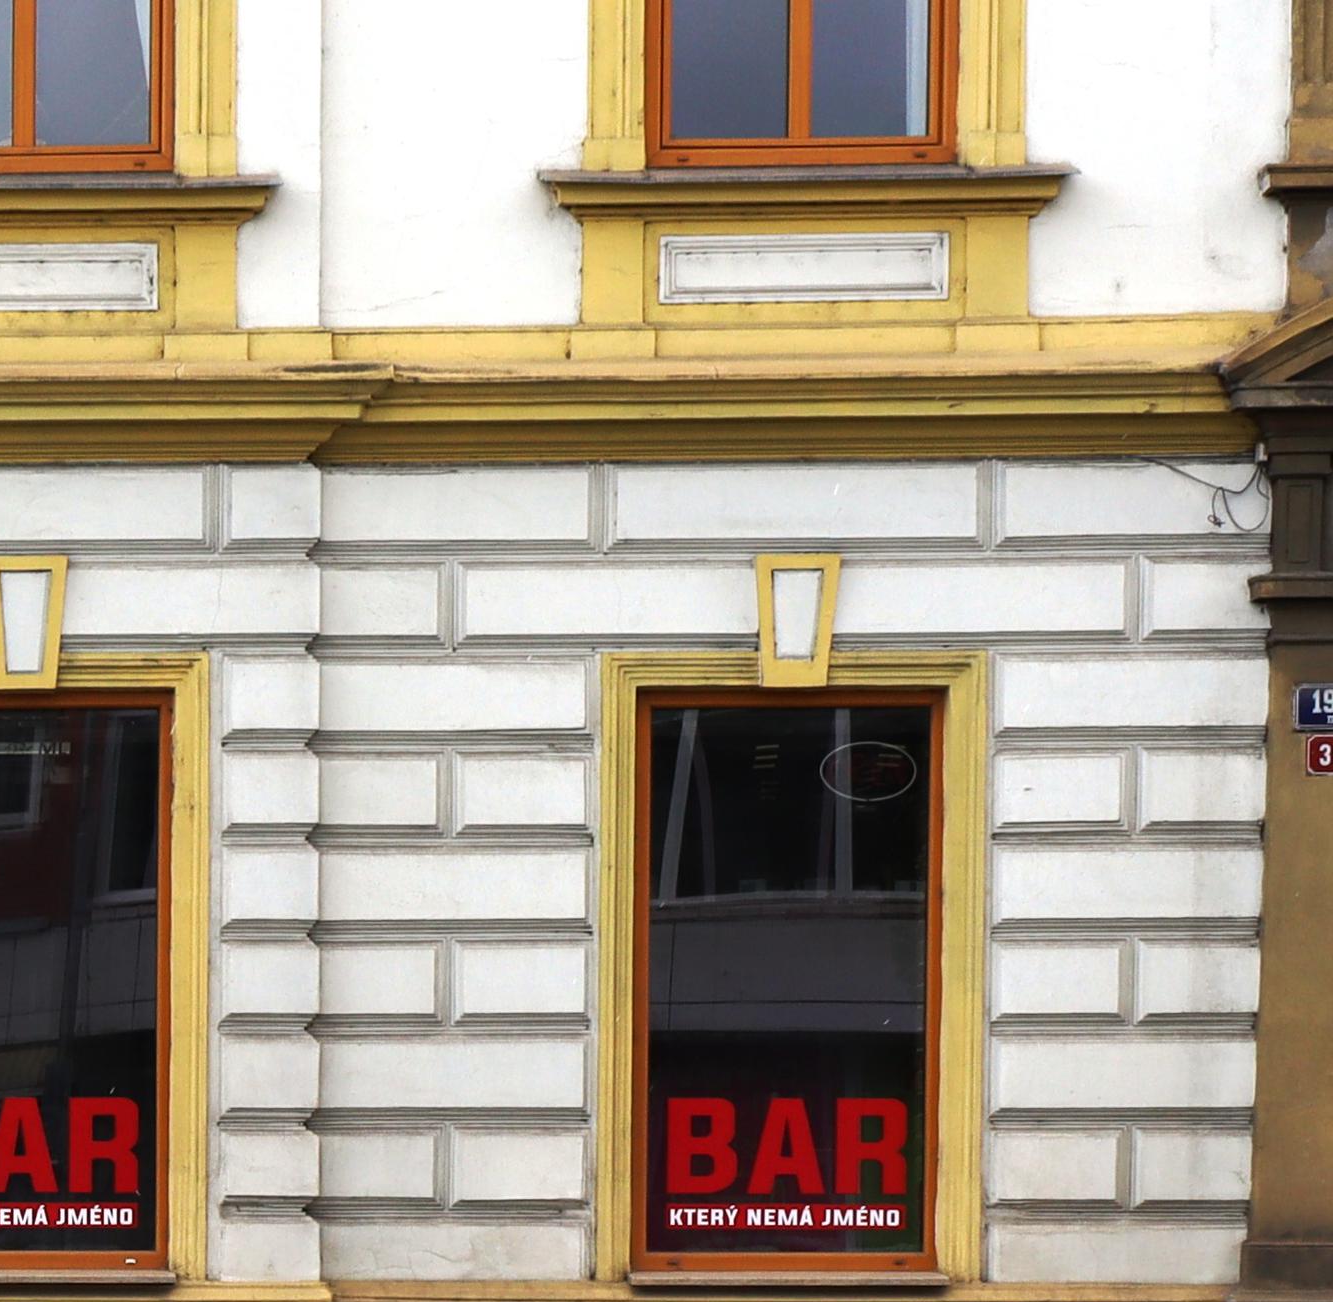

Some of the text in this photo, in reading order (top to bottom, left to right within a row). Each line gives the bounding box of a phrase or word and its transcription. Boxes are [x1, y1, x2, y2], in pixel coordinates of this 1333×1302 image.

[1319, 743, 1332, 767] 3
[667, 1098, 907, 1194] BAR
[56, 1205, 133, 1225] JMÉNO
[669, 1205, 900, 1227] KTERÝ NEMÁ JMÉNO
